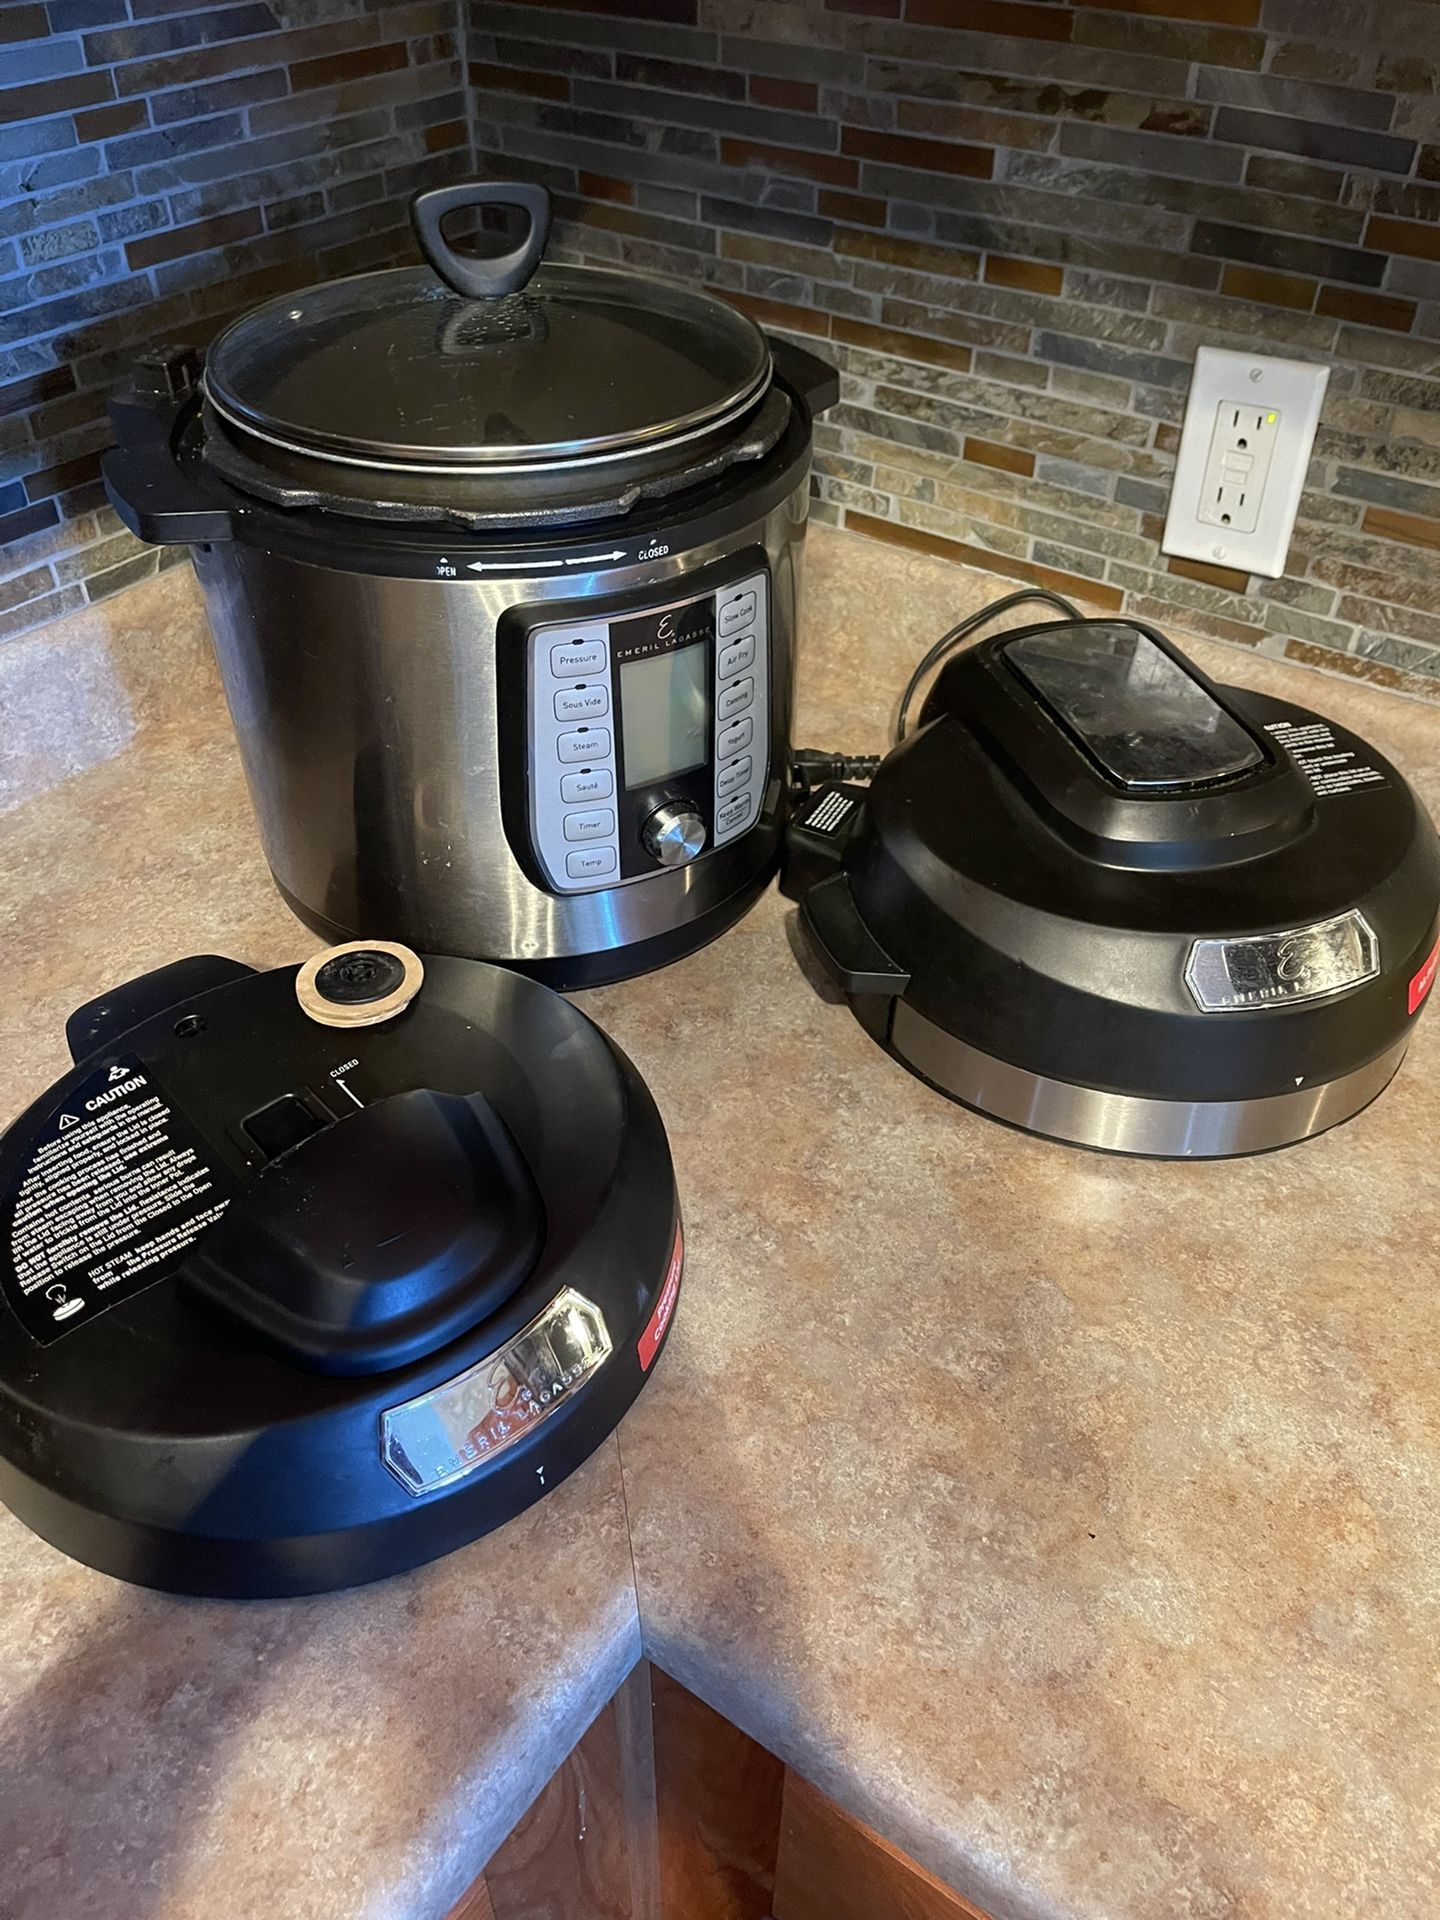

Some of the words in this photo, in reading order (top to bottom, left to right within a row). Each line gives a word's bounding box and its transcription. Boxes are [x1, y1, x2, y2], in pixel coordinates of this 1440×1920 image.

[638, 545, 669, 561] CLOSED
[560, 654, 597, 665] Pressure
[562, 701, 583, 710] Sous
[584, 698, 602, 707] Vide
[573, 741, 598, 751] Steam
[579, 821, 601, 830] Timer
[581, 859, 602, 868] Temp
[330, 1059, 359, 1078] CLOSED
[85, 1074, 147, 1110] CAUTION
